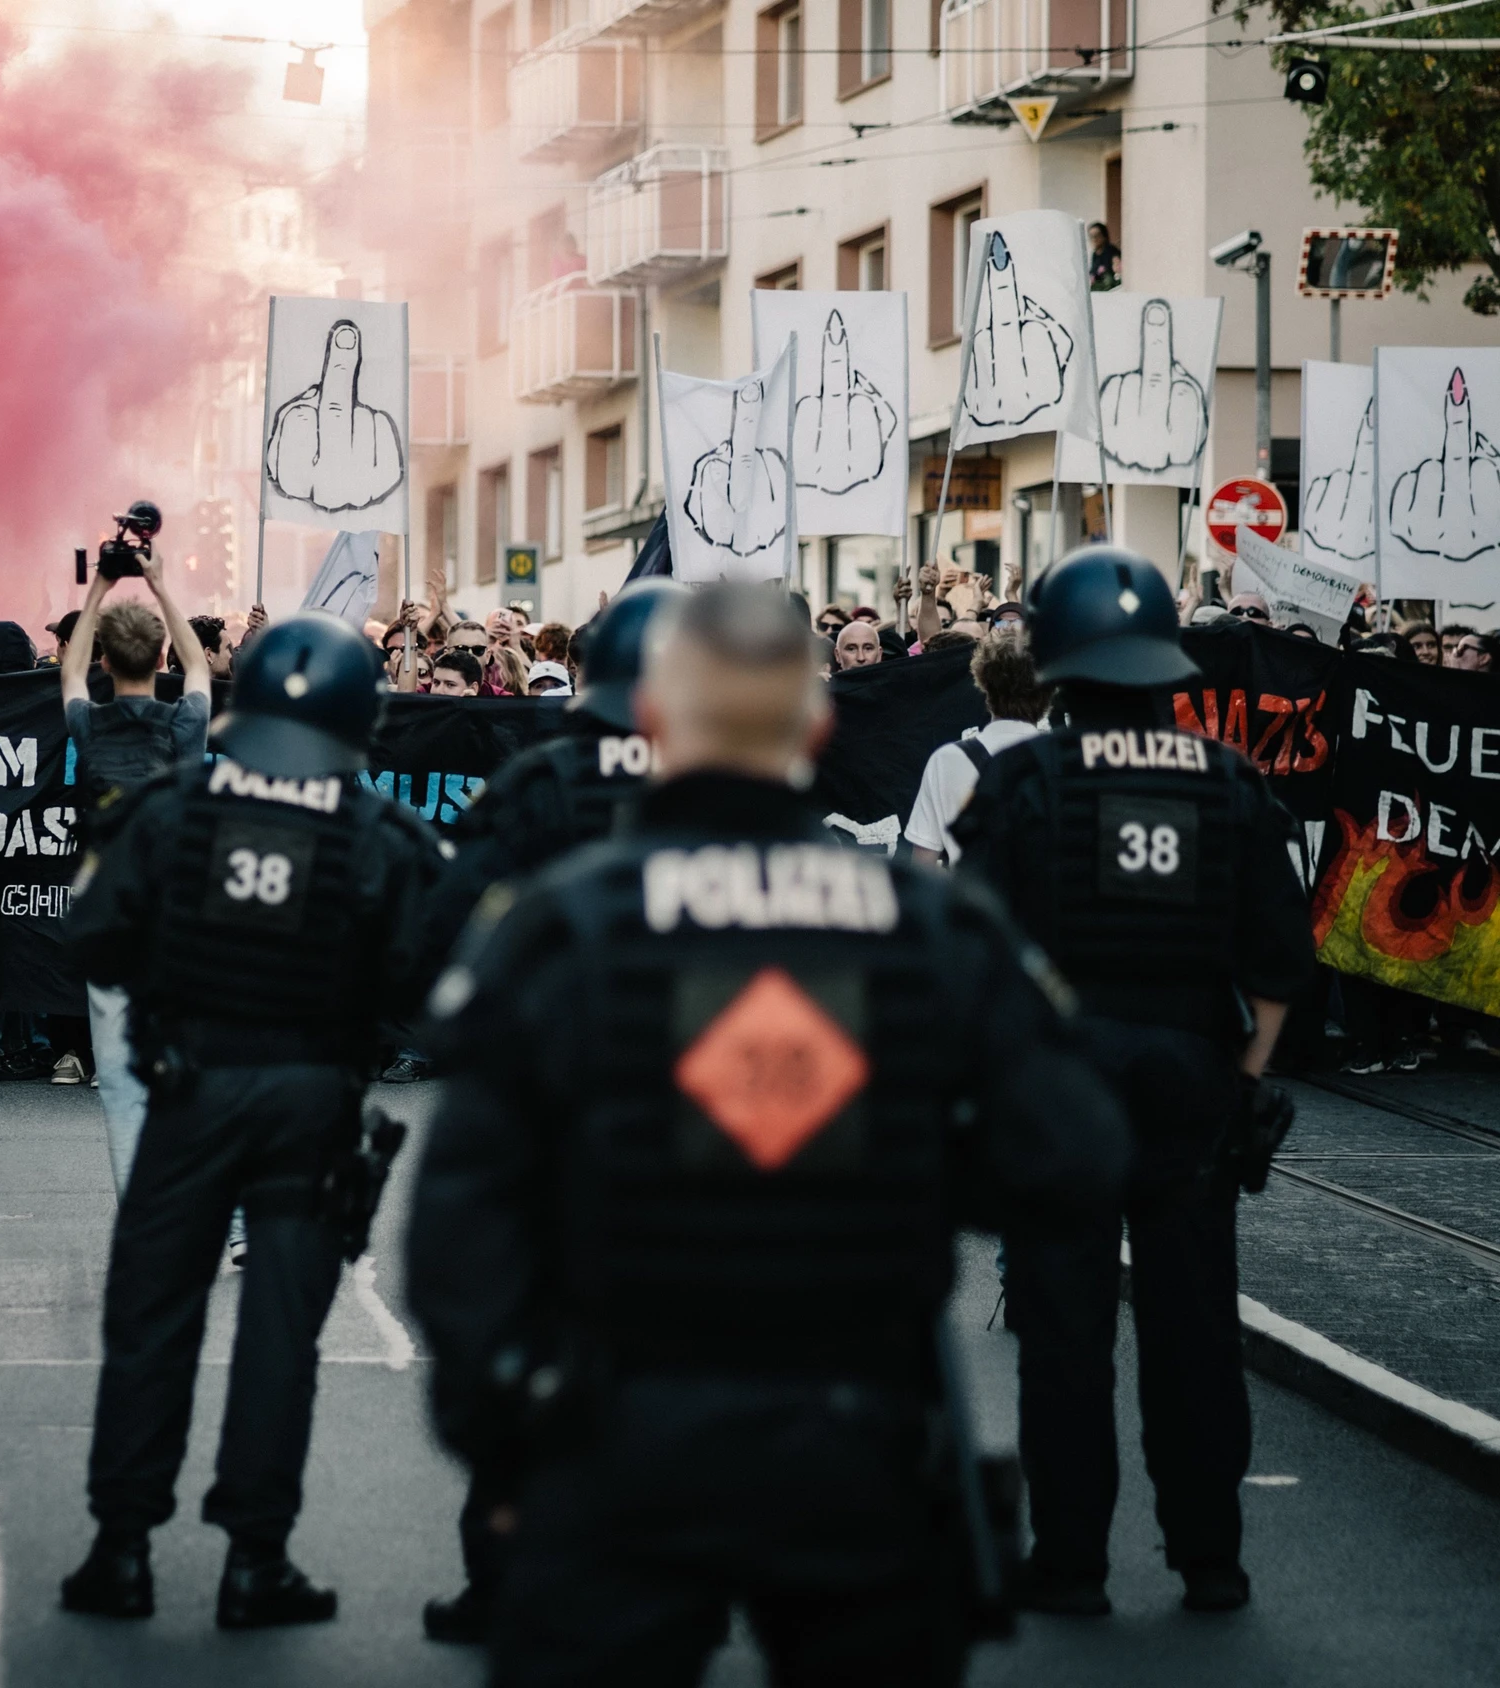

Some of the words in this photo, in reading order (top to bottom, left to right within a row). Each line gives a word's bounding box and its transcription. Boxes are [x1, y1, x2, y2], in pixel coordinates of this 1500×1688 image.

[1080, 729, 1208, 772] POLIZEI
[1173, 688, 1329, 776] NAZIS
[354, 769, 486, 825] MUS
[1117, 821, 1180, 875] 38
[224, 848, 293, 906] 38
[642, 842, 899, 935] POLIZEI
